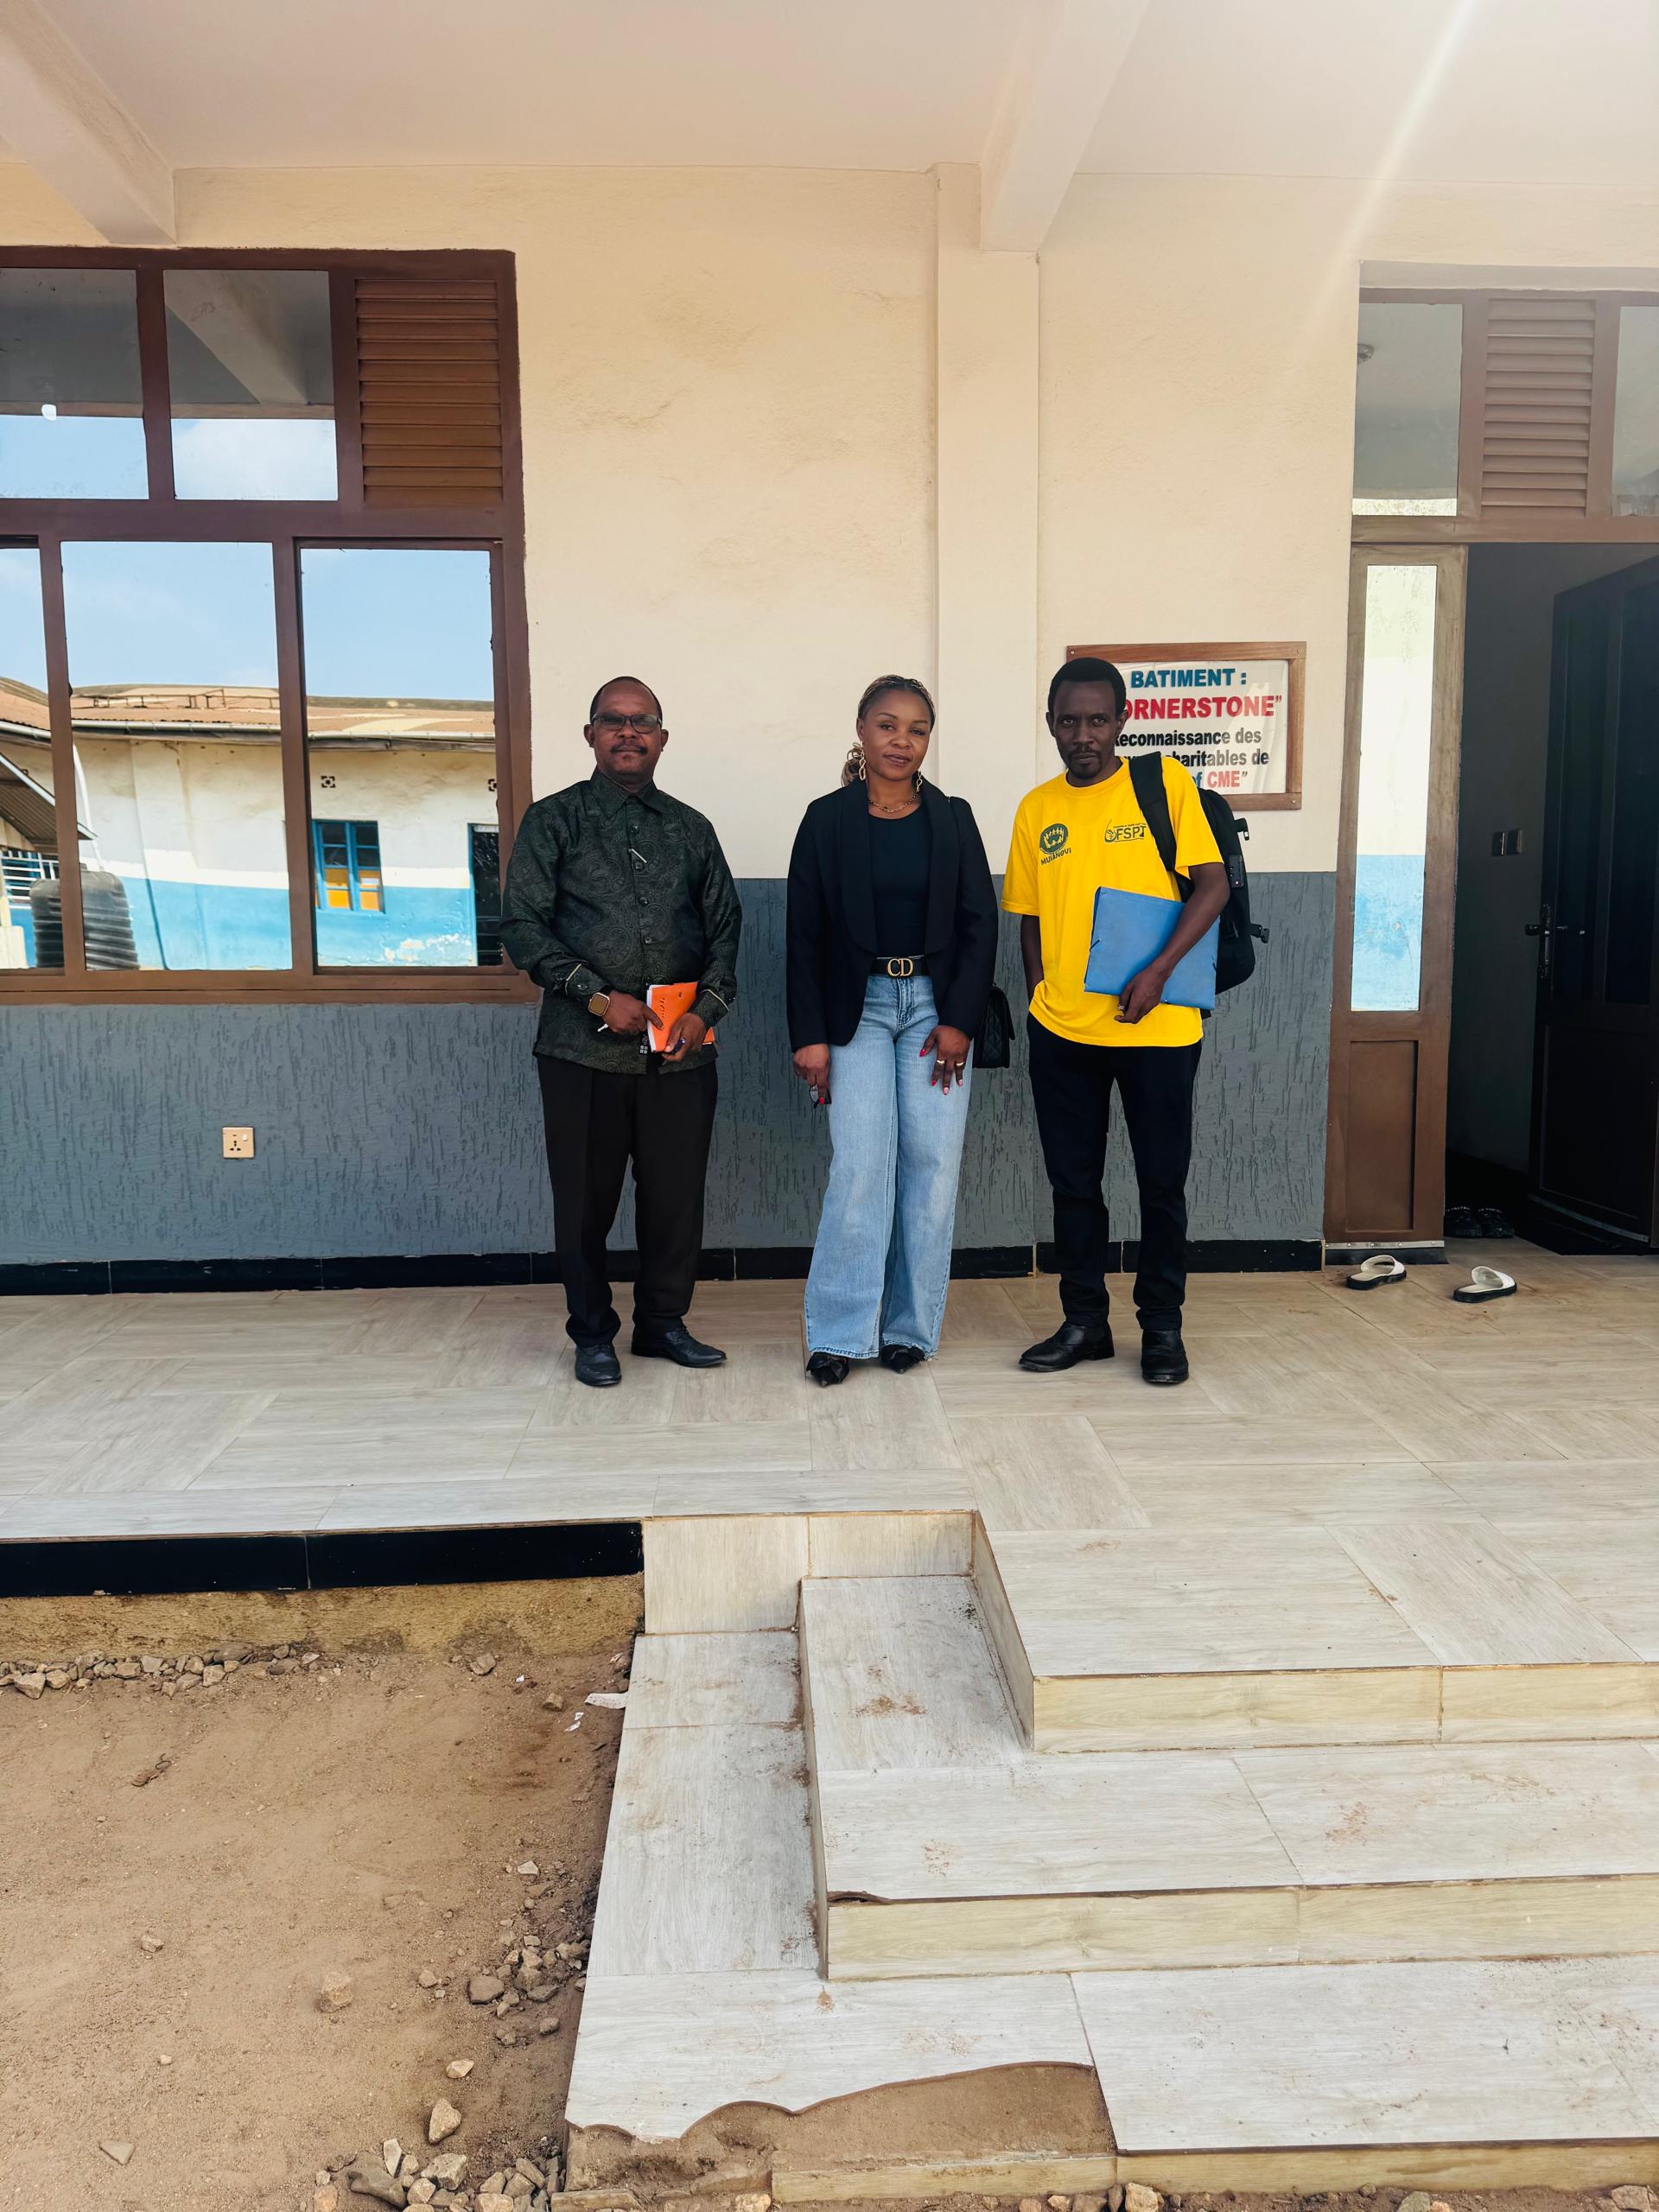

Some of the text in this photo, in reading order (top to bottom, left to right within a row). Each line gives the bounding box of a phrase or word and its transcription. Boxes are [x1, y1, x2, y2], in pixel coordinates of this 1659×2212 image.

[1131, 668, 1236, 688] BATIMENT
[1235, 727, 1262, 744] des
[1251, 748, 1269, 766] de
[887, 957, 913, 976] CD
